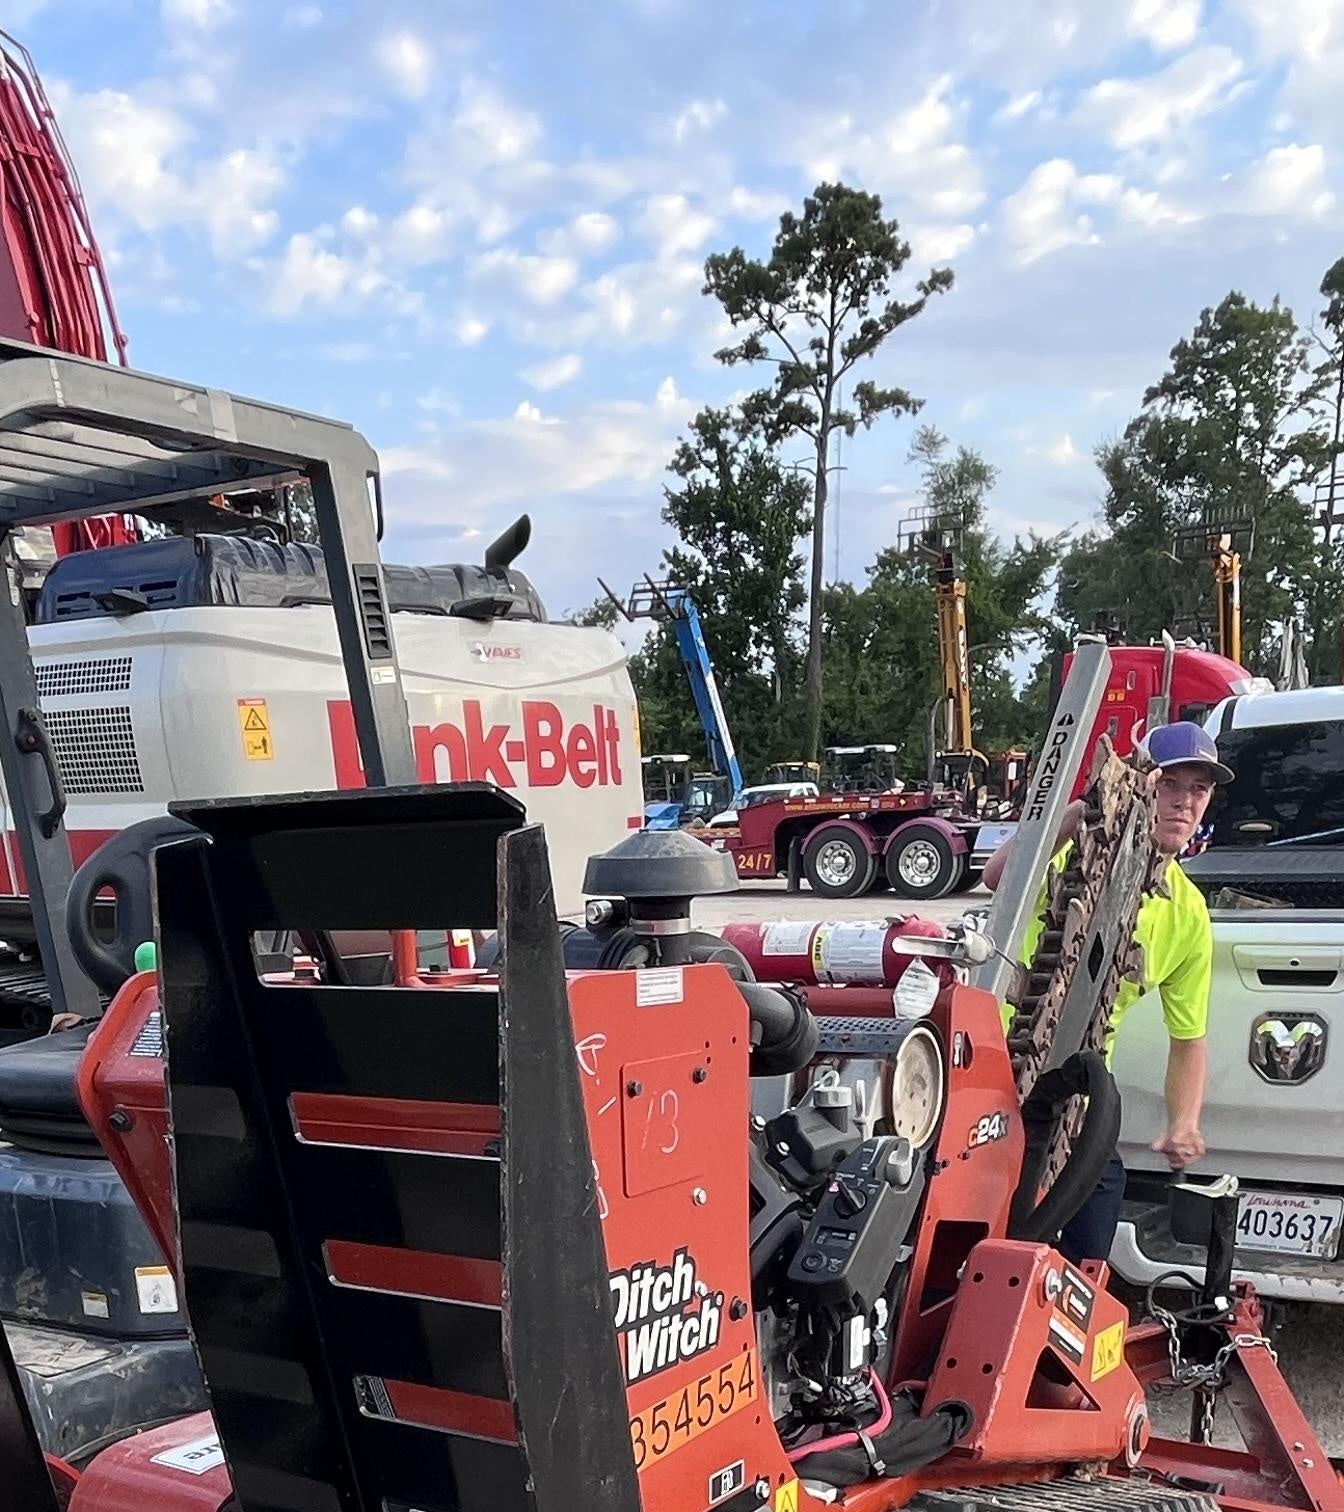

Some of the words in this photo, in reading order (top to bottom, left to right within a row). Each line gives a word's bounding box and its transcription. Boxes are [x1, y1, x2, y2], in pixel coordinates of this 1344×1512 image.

[326, 699, 622, 790] Lnk-Belt
[1026, 731, 1069, 821] DANGER
[738, 853, 773, 871] 24/7
[813, 936, 823, 962] ABC
[1238, 1208, 1334, 1243] 403637
[625, 1298, 721, 1381] Witch
